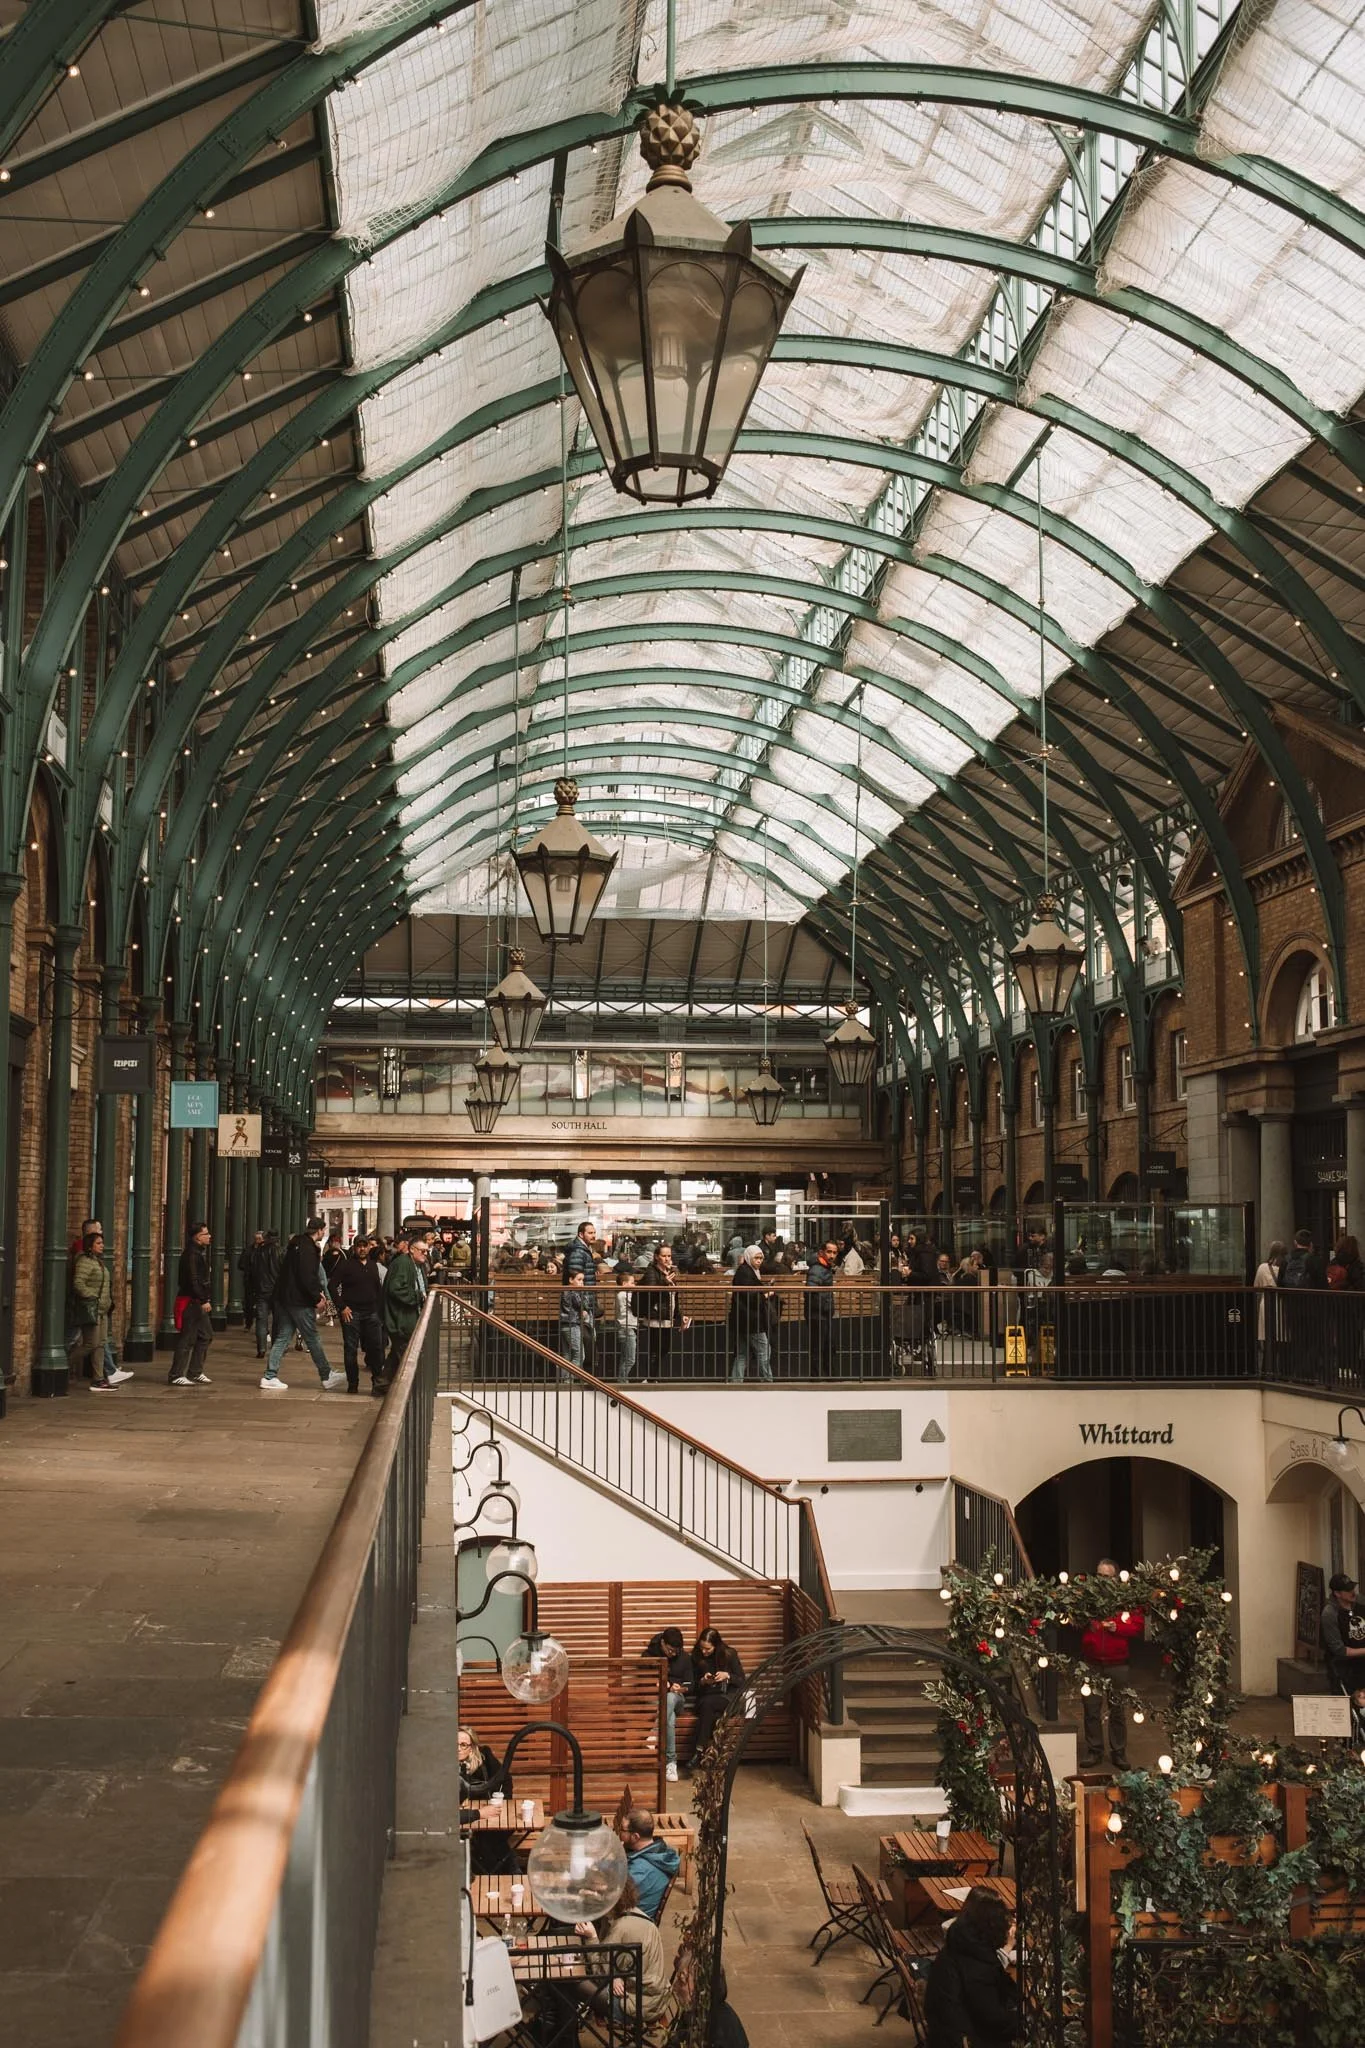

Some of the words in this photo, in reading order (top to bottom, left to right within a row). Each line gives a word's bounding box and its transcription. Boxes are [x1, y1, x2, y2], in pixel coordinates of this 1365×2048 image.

[551, 1121, 582, 1130] SOUTH
[583, 1121, 608, 1130] HALL
[1079, 1422, 1175, 1445] Whittard
[1289, 1439, 1310, 1459] Sass
[1312, 1438, 1318, 1458] &
